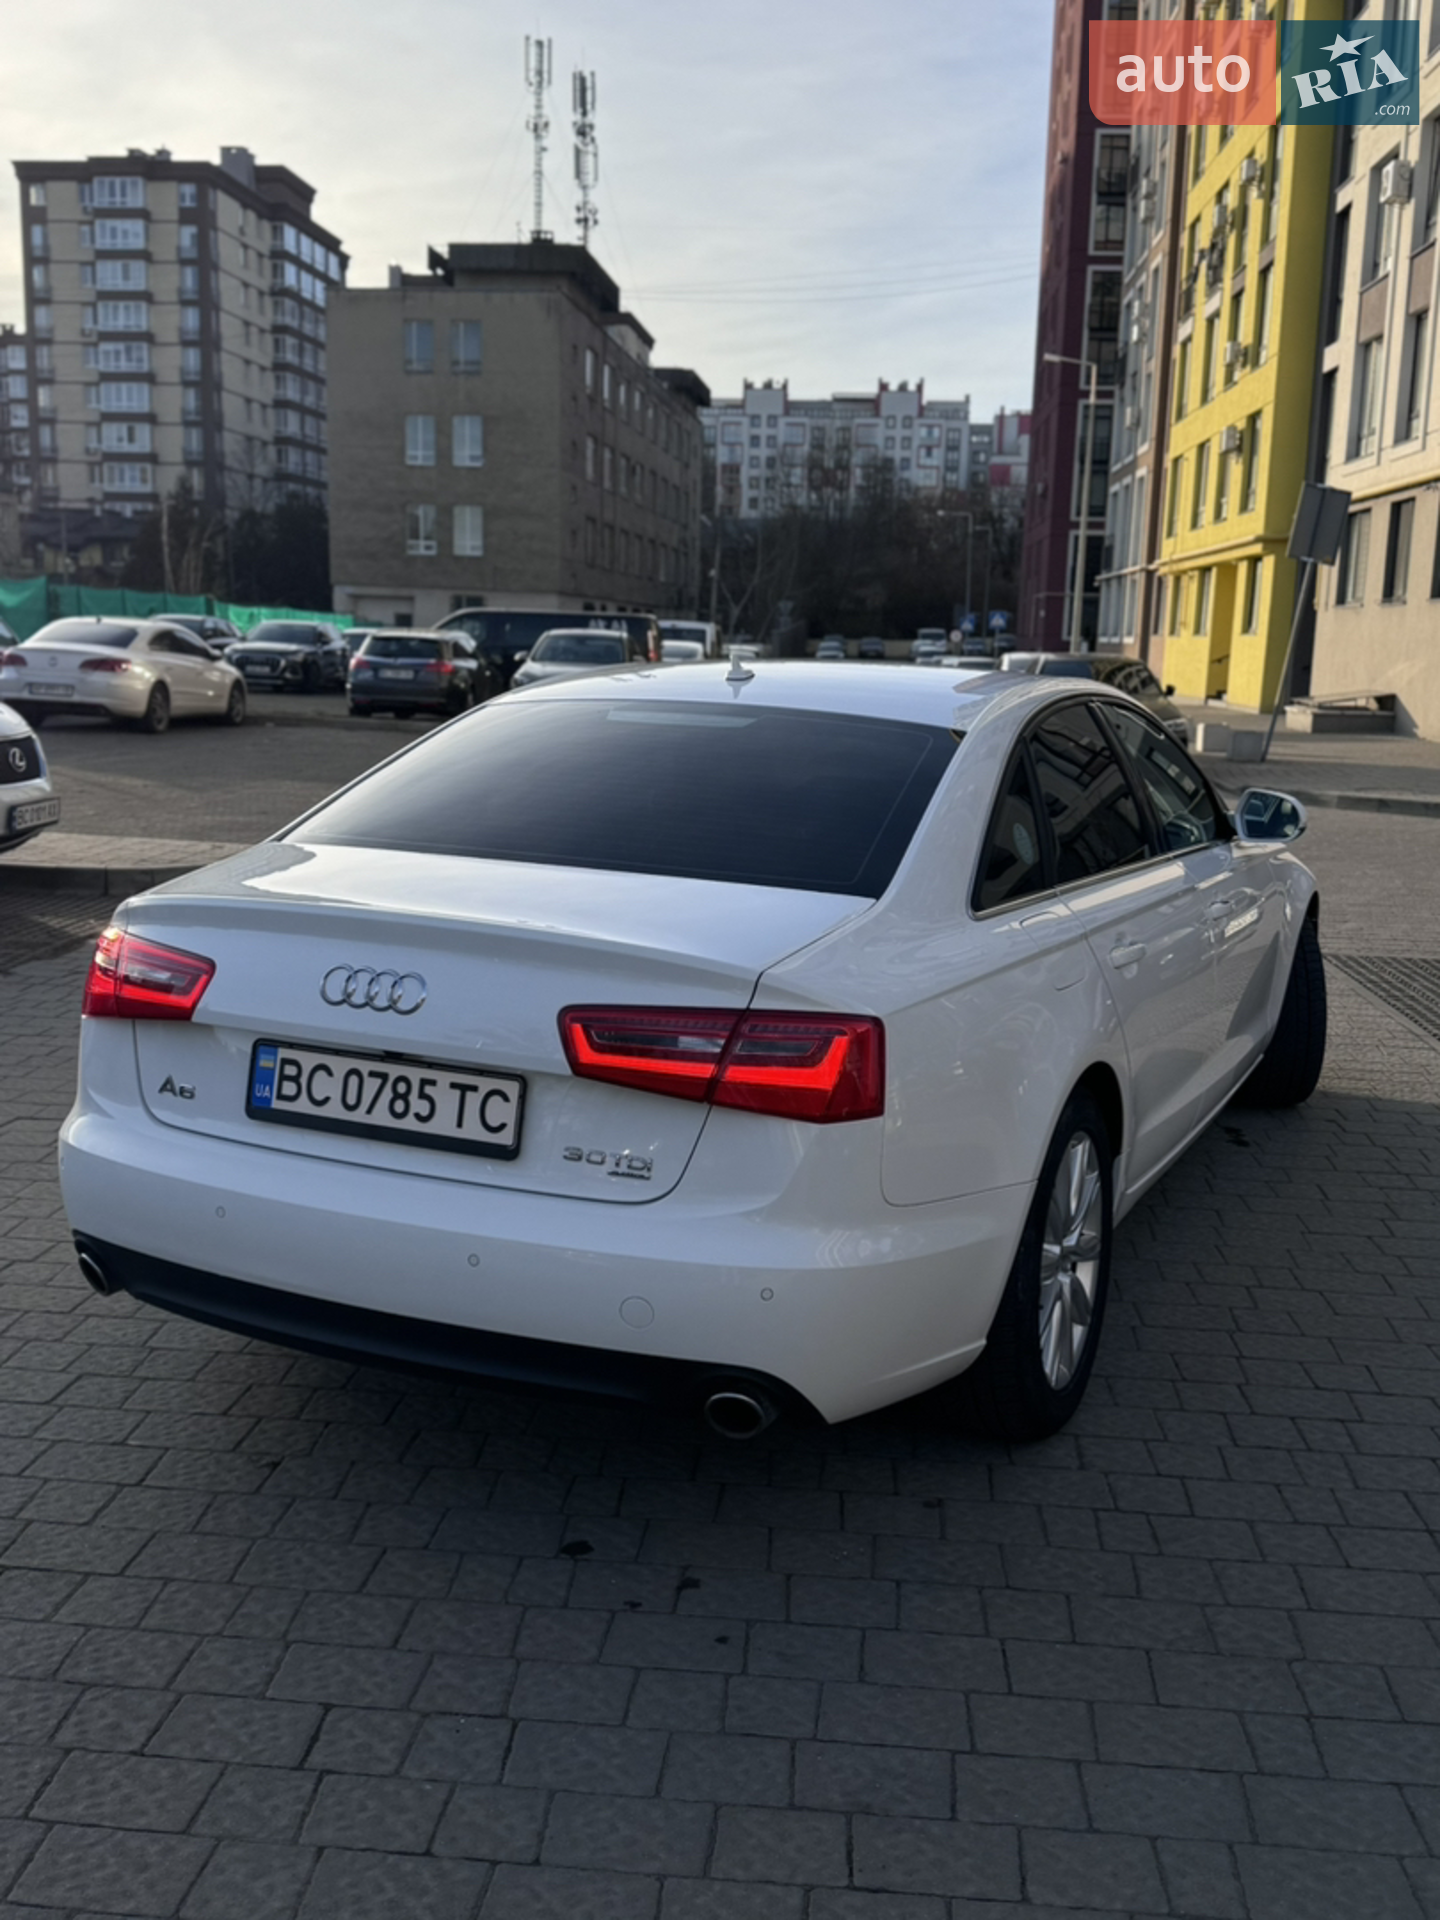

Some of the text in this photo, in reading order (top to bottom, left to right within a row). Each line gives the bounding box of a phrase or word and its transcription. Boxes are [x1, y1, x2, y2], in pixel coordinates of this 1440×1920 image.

[157, 1074, 196, 1100] A6
[255, 1083, 271, 1098] UA
[275, 1057, 512, 1134] BC 0785 TC
